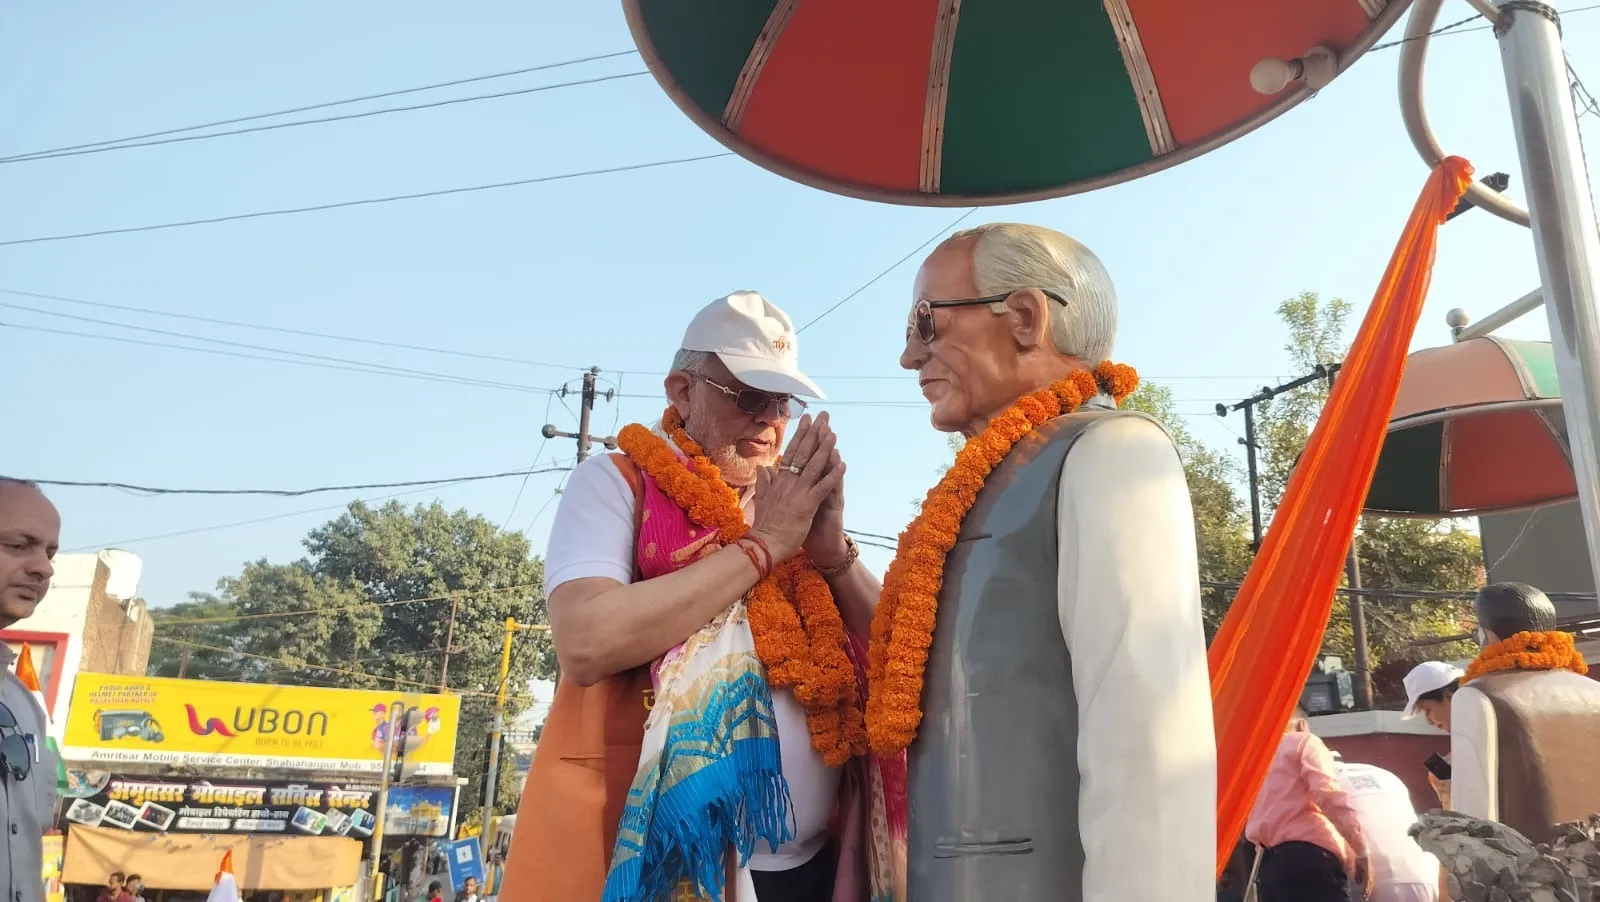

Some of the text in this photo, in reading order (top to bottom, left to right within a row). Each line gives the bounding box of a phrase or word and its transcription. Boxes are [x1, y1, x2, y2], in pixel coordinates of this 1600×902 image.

[233, 706, 328, 736] UBON
[256, 737, 278, 745] BORN
[91, 750, 139, 760] Amritsar
[143, 752, 179, 761] Mobile
[183, 754, 221, 763] Service
[266, 758, 336, 770] Shahjahanpur
[109, 781, 187, 806] अमृतसर
[192, 780, 266, 806] मोबाइल
[271, 784, 323, 806] सर्विस
[178, 805, 212, 817] मोबाइल
